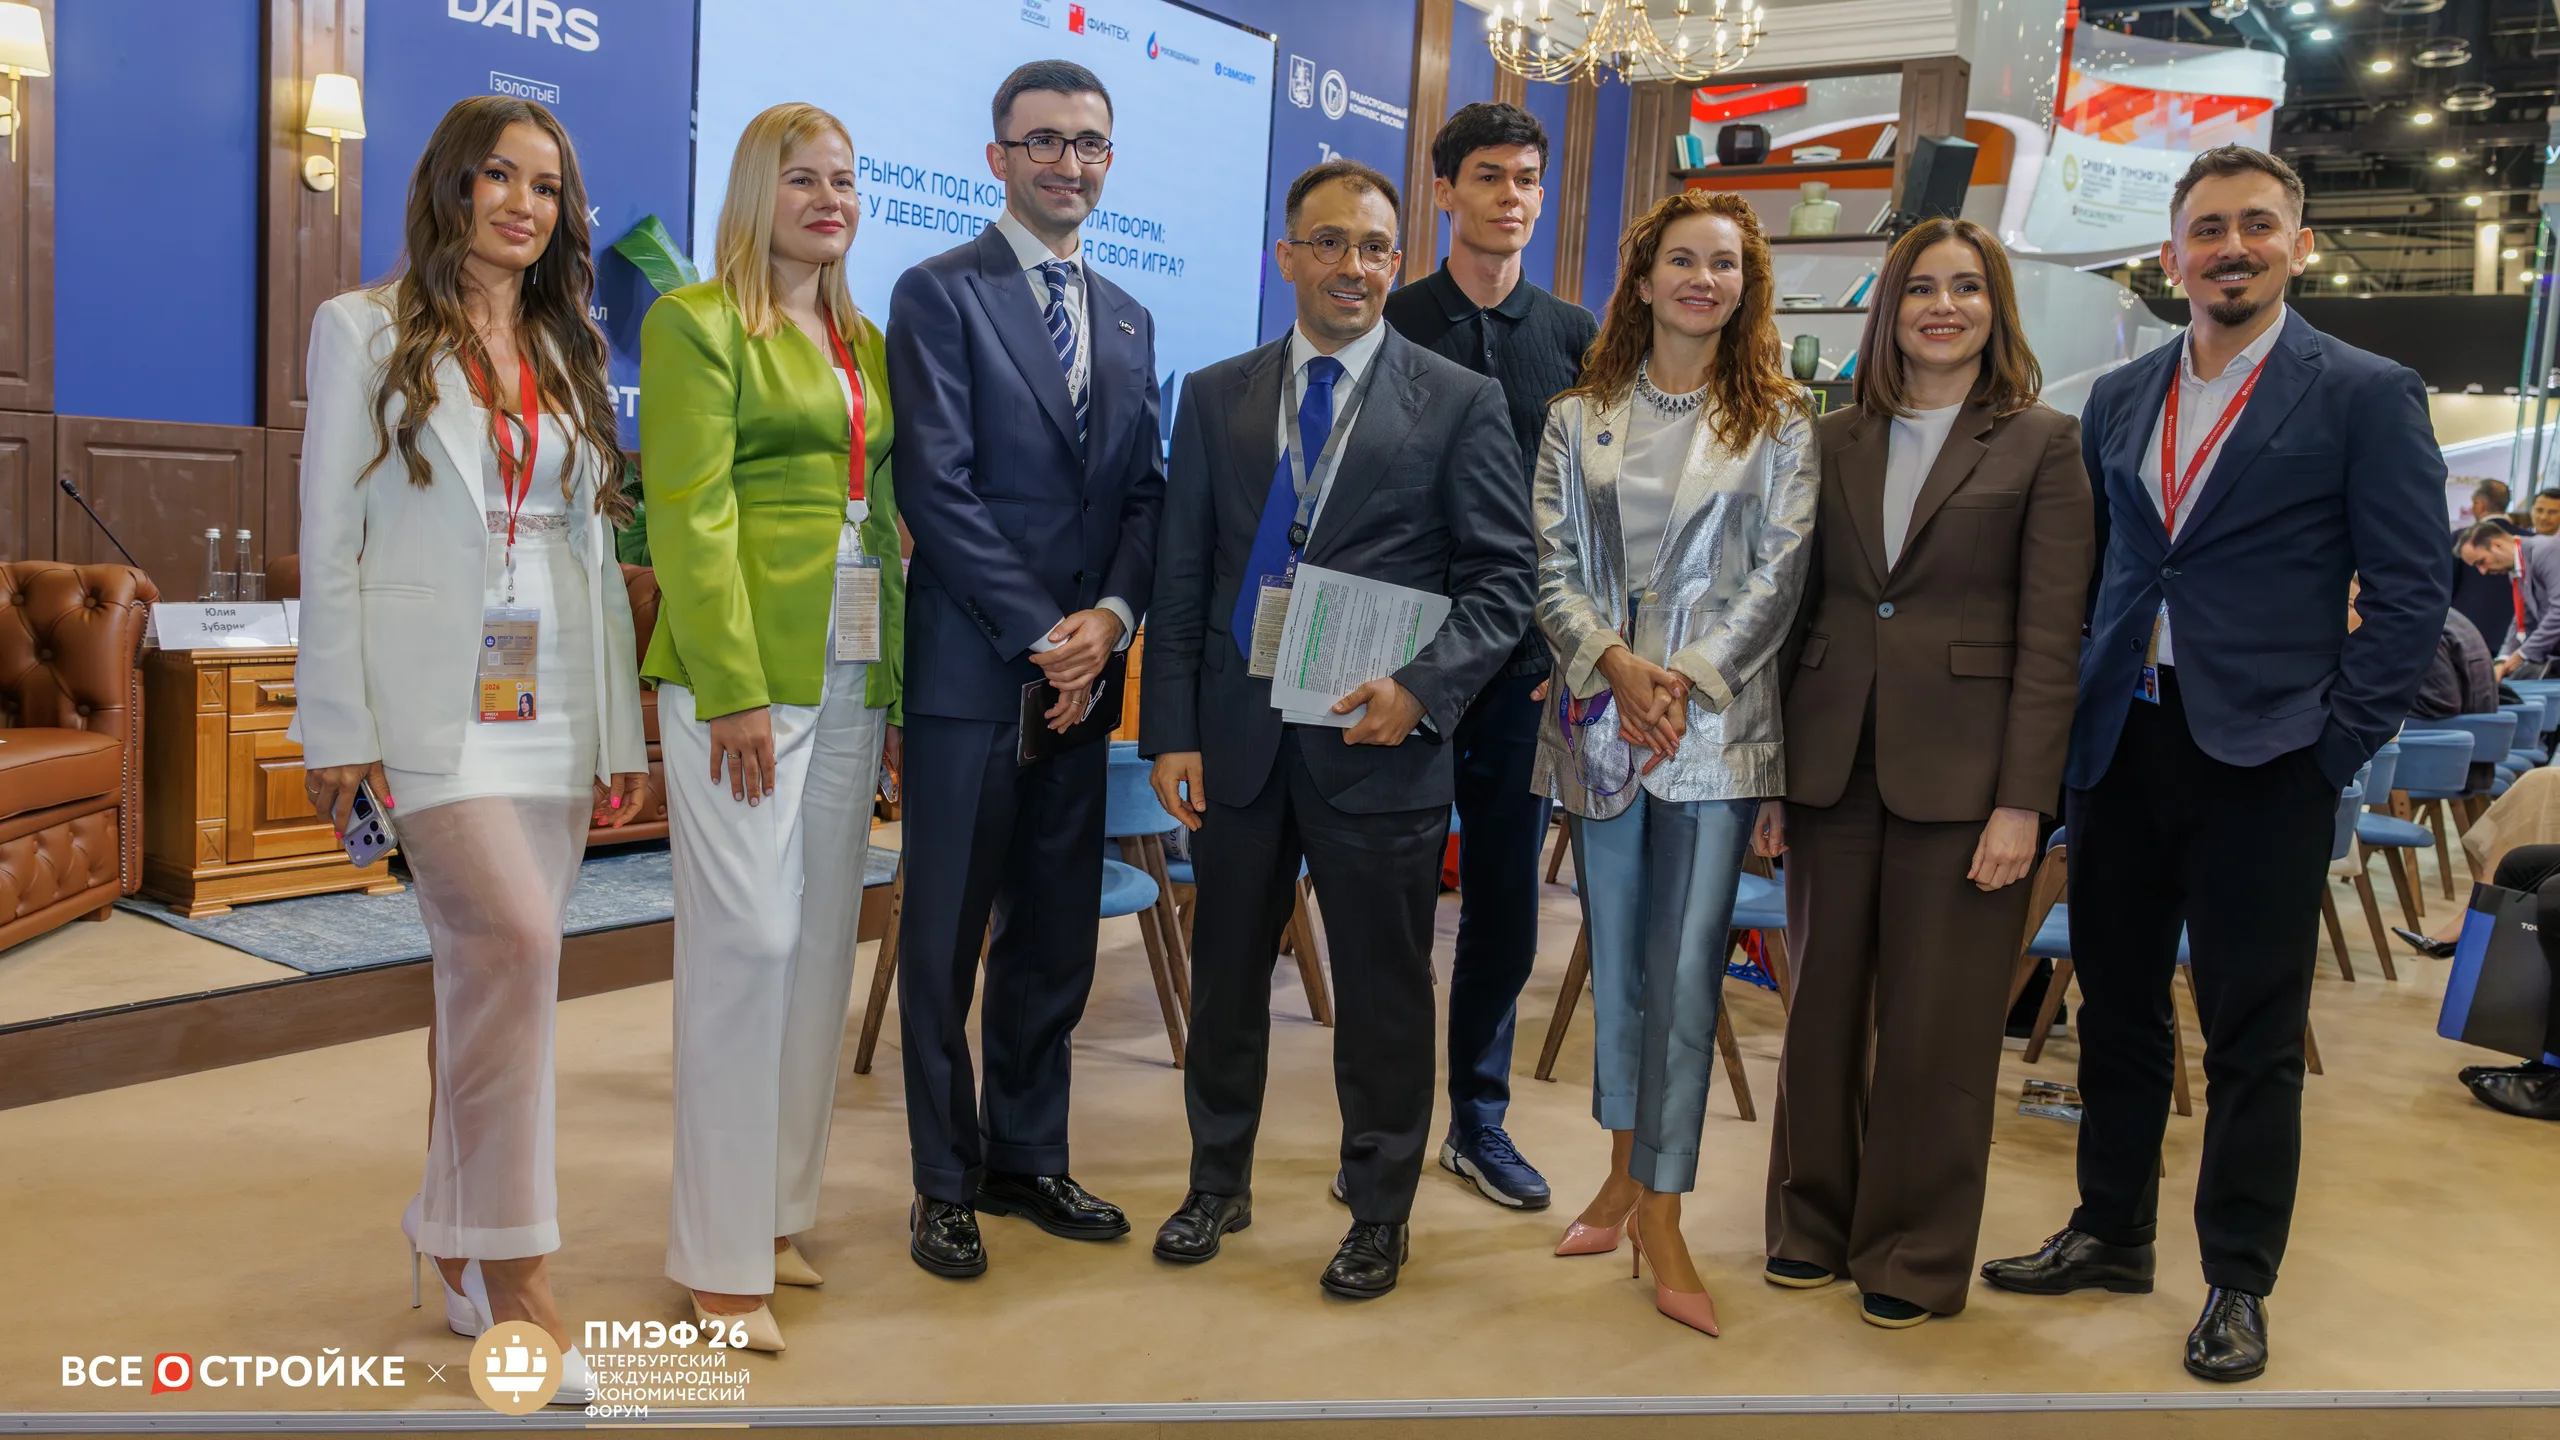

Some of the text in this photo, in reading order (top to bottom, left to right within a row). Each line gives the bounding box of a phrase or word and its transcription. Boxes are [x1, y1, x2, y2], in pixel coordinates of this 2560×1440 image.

[448, 0, 600, 51] DARS
[1087, 18, 1130, 42] ФИНТЕХ
[494, 78, 556, 104] ЗОЛОТЫЕ
[858, 156, 926, 193] РЫНОК
[931, 172, 970, 206] ПОД
[869, 194, 882, 218] У
[1097, 242, 1138, 269] СВОЯ
[1142, 251, 1185, 277] ИГРА?
[205, 608, 236, 617] Юлия
[201, 622, 246, 633] Зубарик
[484, 683, 500, 691] 2026
